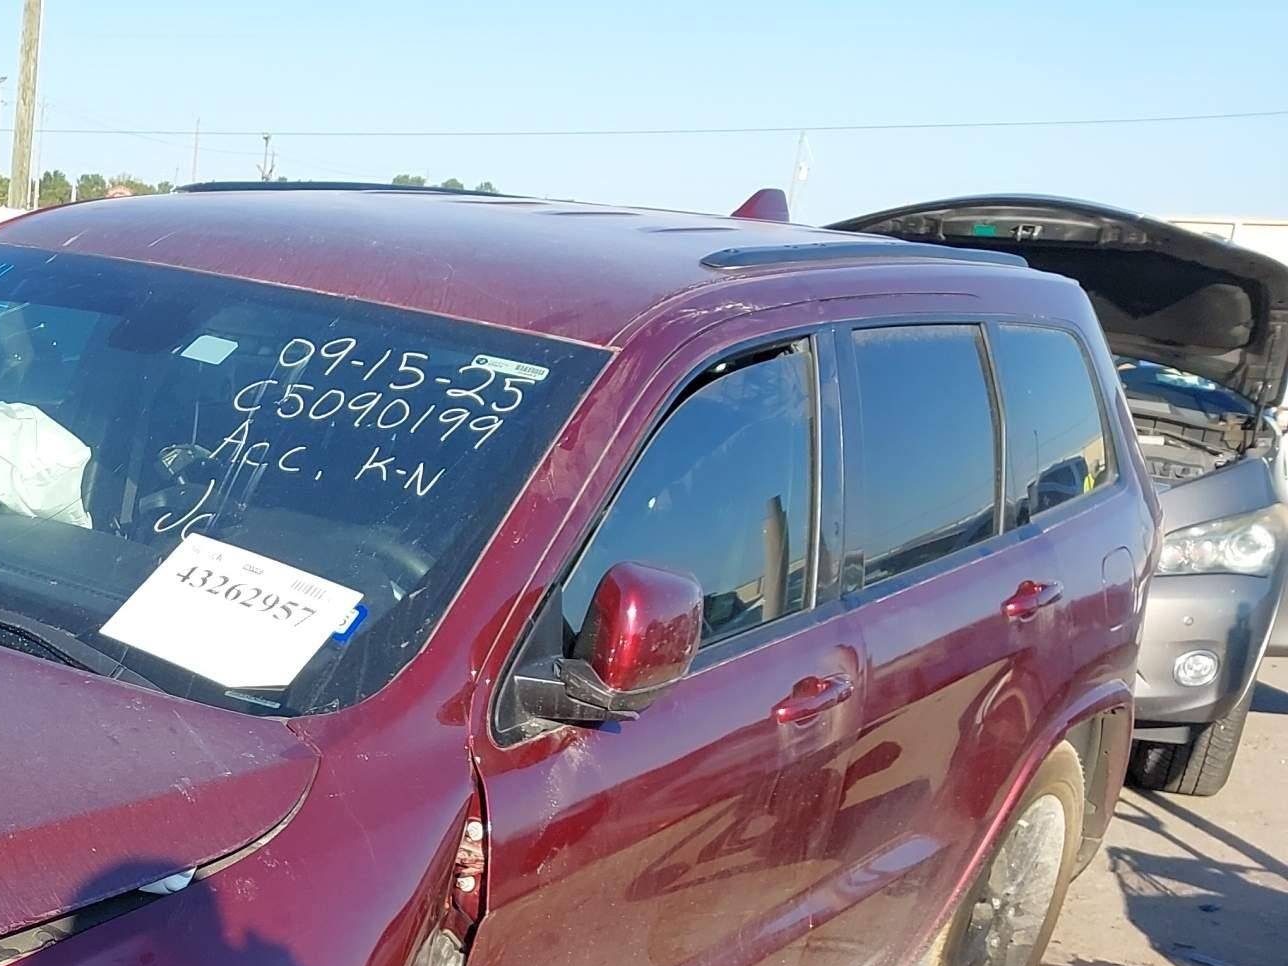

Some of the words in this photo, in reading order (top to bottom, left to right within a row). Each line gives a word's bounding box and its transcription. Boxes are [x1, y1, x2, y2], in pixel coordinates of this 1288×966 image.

[278, 337, 536, 413] 09-15-25
[233, 380, 504, 450] C5090199
[354, 446, 447, 496] K-N
[175, 565, 317, 627] 43262957
